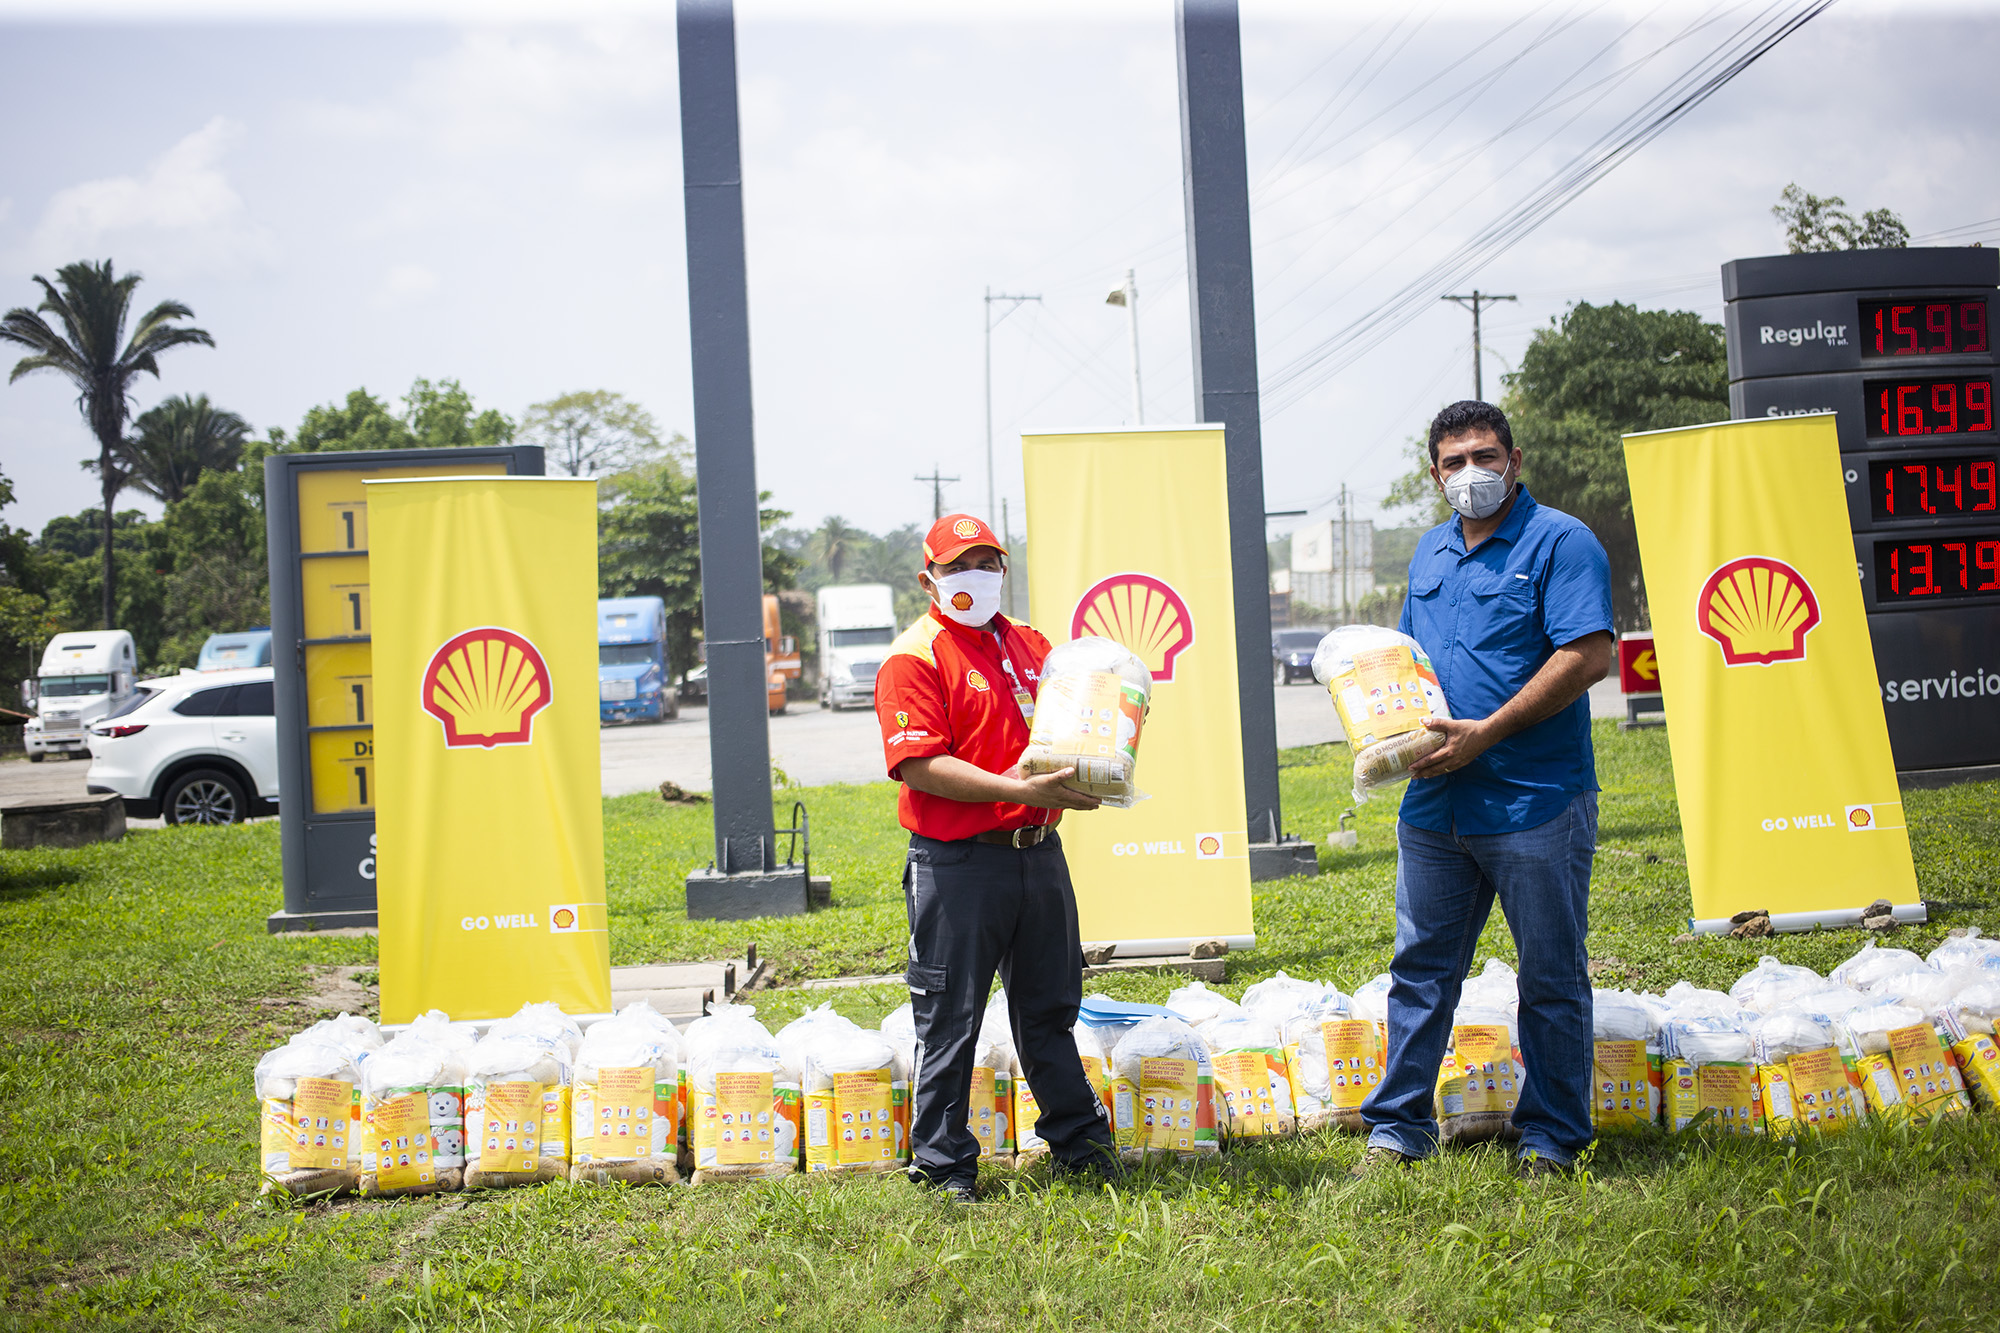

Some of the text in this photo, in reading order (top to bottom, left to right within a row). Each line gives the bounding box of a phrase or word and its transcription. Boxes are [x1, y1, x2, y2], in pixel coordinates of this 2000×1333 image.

[1760, 320, 1847, 346] Regular
[1875, 303, 1986, 355] 15.99
[1880, 381, 1992, 436] 16.99
[1886, 461, 1996, 514] 17.49
[1890, 540, 2000, 596] 13.79
[1381, 736, 1413, 752] MORENA
[1761, 814, 1836, 832] GO WELL
[1112, 841, 1186, 856] GO WELL
[461, 914, 538, 931] GO WELL
